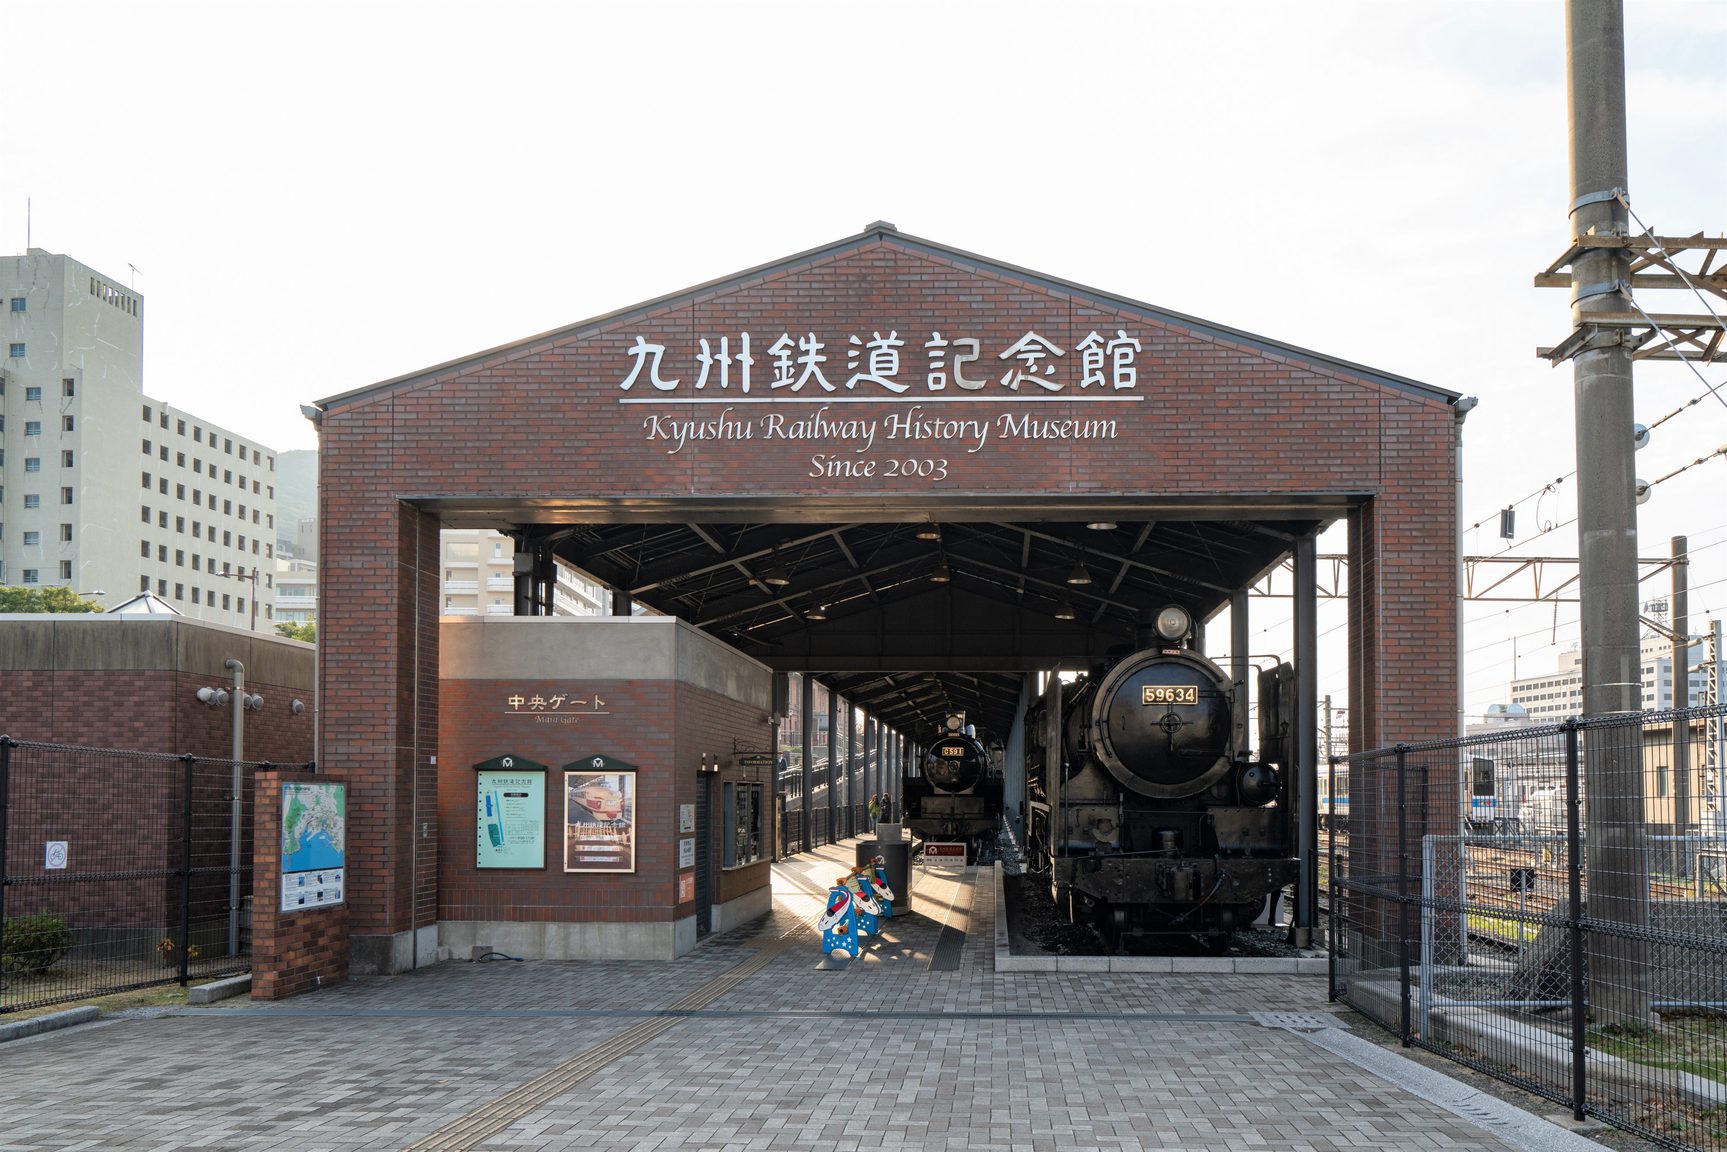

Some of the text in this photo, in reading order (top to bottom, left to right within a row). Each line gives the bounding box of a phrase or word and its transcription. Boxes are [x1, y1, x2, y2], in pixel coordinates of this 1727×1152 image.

[619, 330, 1142, 393] 九州鉄道記念館
[643, 405, 1118, 454] Kyushu Railway History Museum
[808, 454, 949, 481] Since 2003
[508, 694, 606, 711] 中央ゲート
[1145, 688, 1195, 702] 59634
